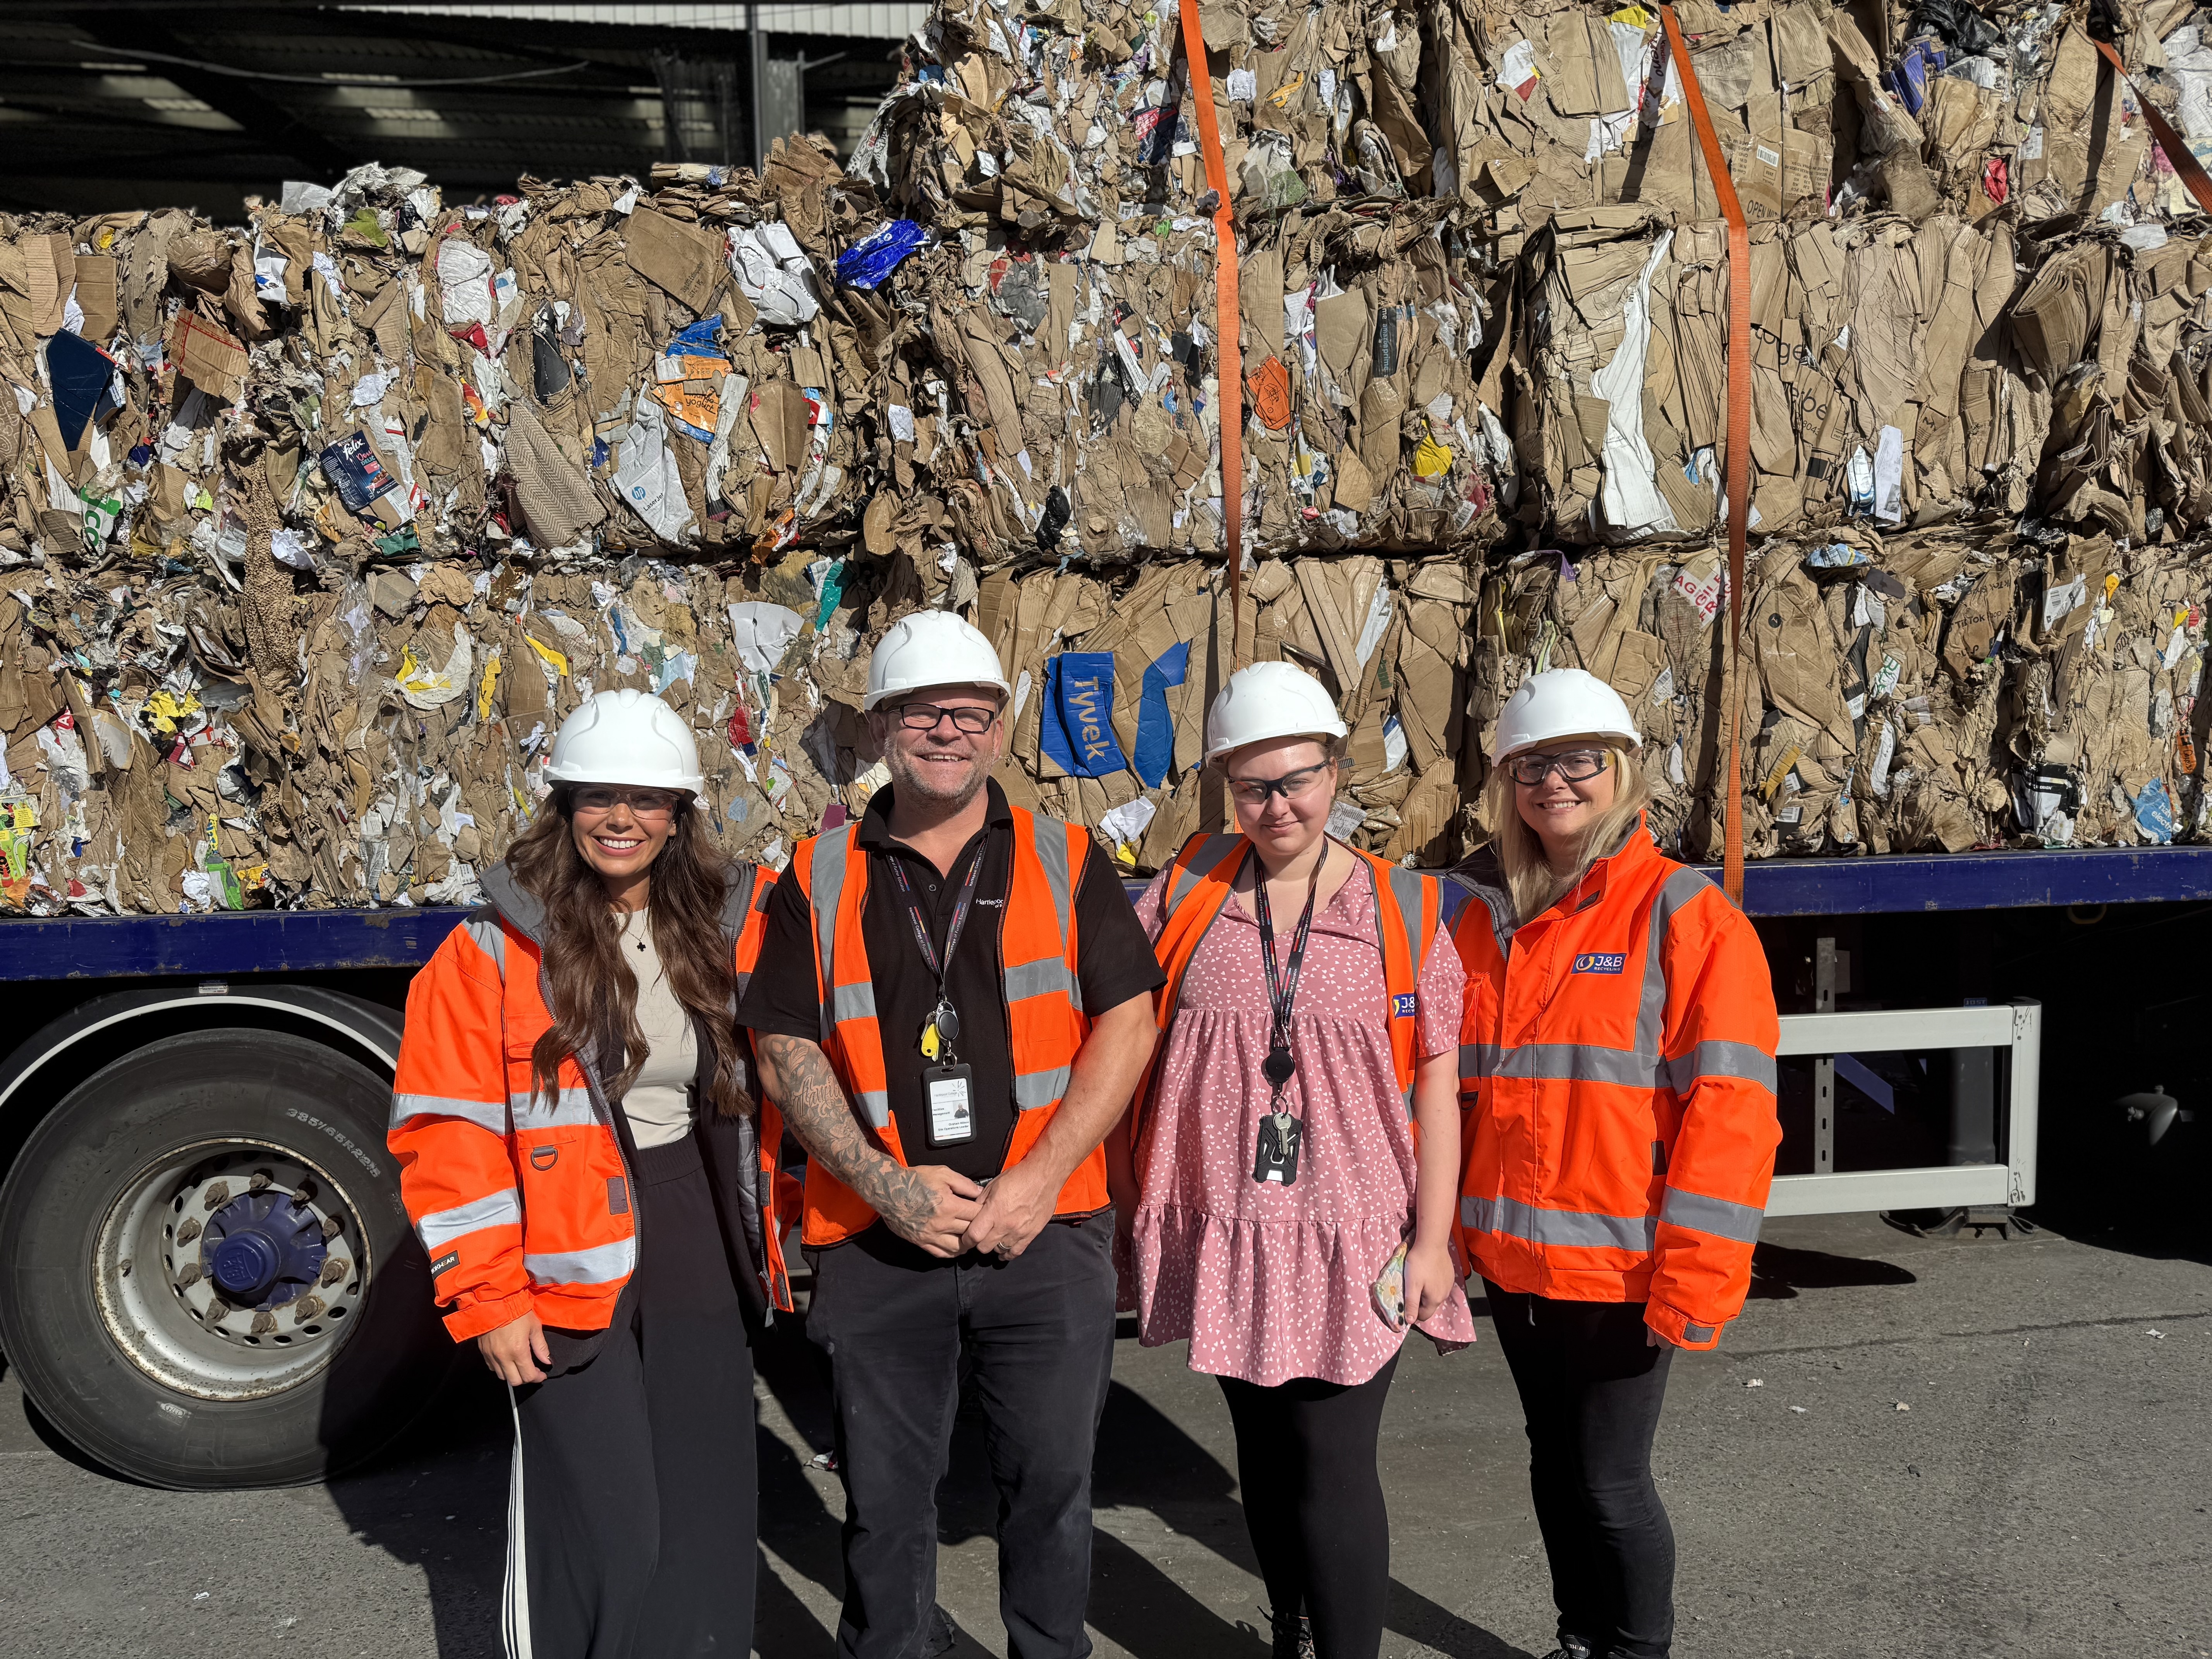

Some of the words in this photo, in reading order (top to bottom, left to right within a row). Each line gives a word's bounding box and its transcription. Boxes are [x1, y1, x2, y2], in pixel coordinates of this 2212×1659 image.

[1747, 199, 1765, 218] OPEN
[686, 398, 714, 412] yogurt
[360, 455, 376, 466] DELIC
[634, 487, 645, 500] hp
[643, 493, 664, 512] LaserJet
[1954, 614, 1985, 629] TikTok
[1069, 676, 1109, 761] Tyvek
[1595, 956, 1623, 967] J&B
[1401, 997, 1415, 1008] J&
